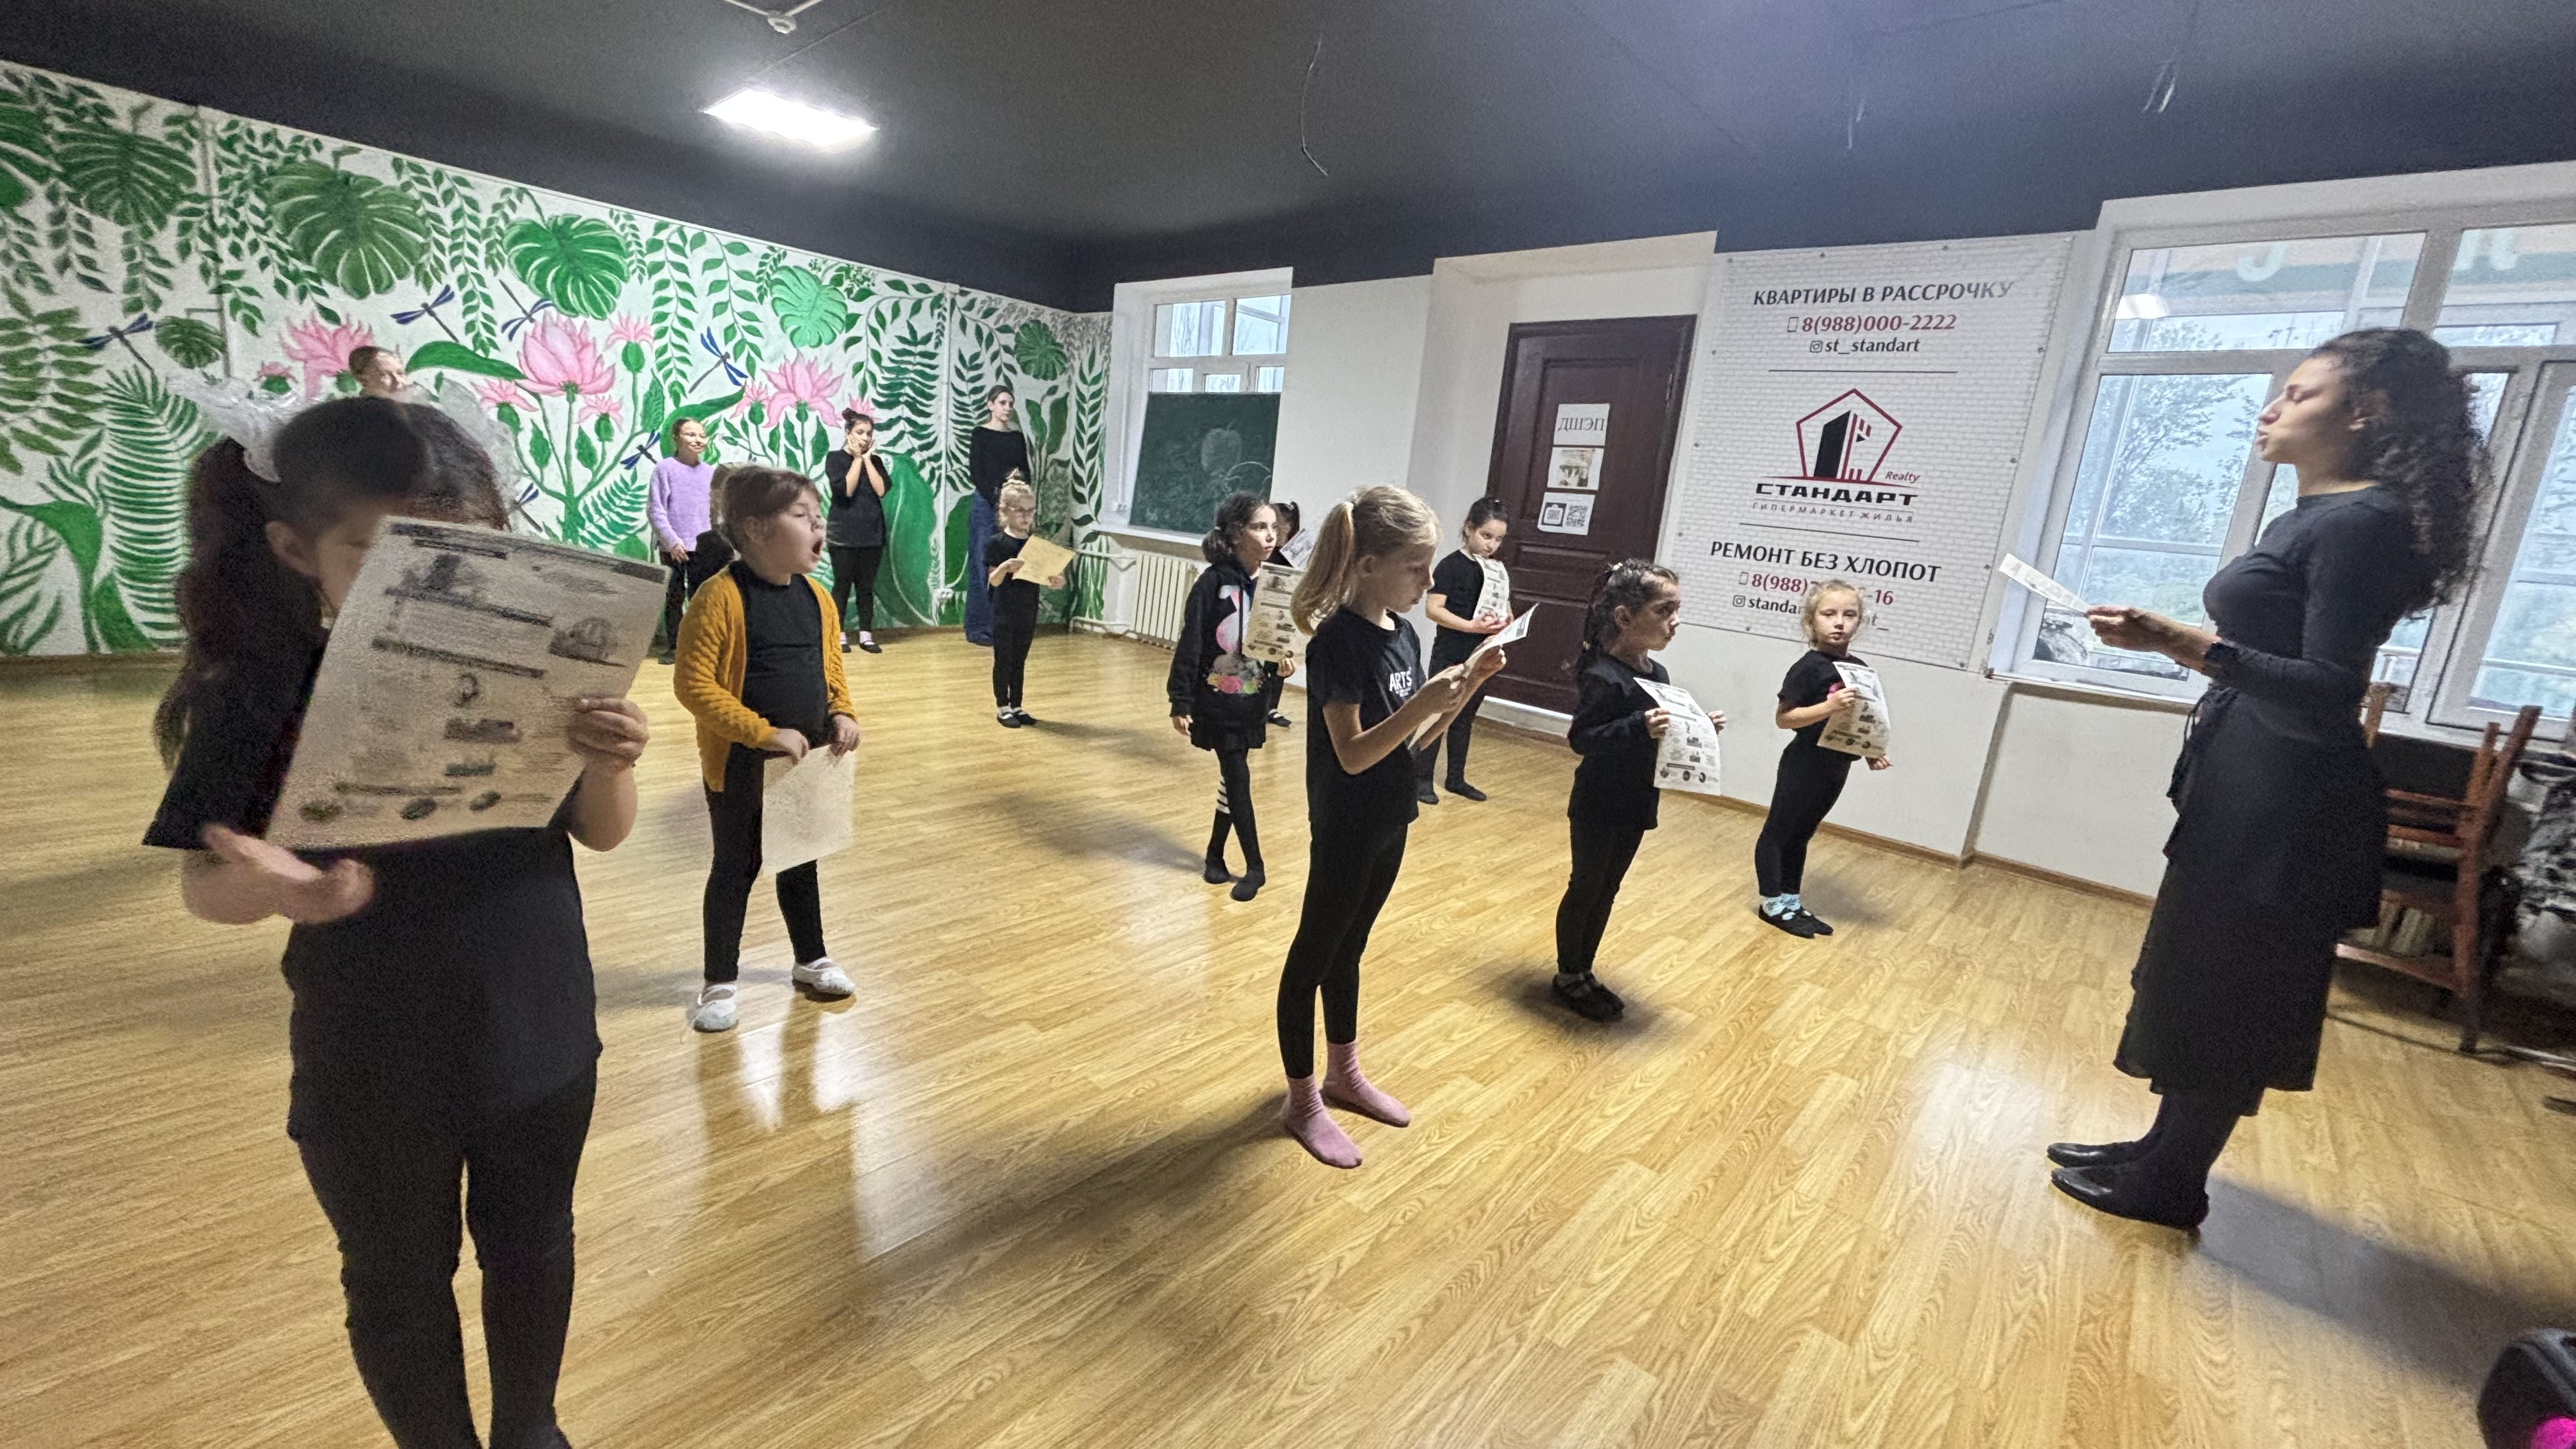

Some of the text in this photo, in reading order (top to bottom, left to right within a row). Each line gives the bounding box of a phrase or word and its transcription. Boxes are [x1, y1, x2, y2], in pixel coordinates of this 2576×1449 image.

[1753, 280, 2016, 305] КВАРТИРЫ В РАССРОЧКУ
[1802, 314, 1958, 334] 8(988)000-2222
[1825, 337, 1920, 355] st_standart
[1558, 417, 1606, 432] ДШЭП
[1885, 471, 1921, 484] Realty
[1756, 483, 1919, 507] СТАНДАРТ
[1752, 503, 1913, 523] ГИПЕРМАРКЕТ ЖИЛЬЯ
[1710, 541, 1942, 583] РЕМОНТ БЕЗ ХЛОПОТ
[1389, 670, 1413, 692] ARTS
